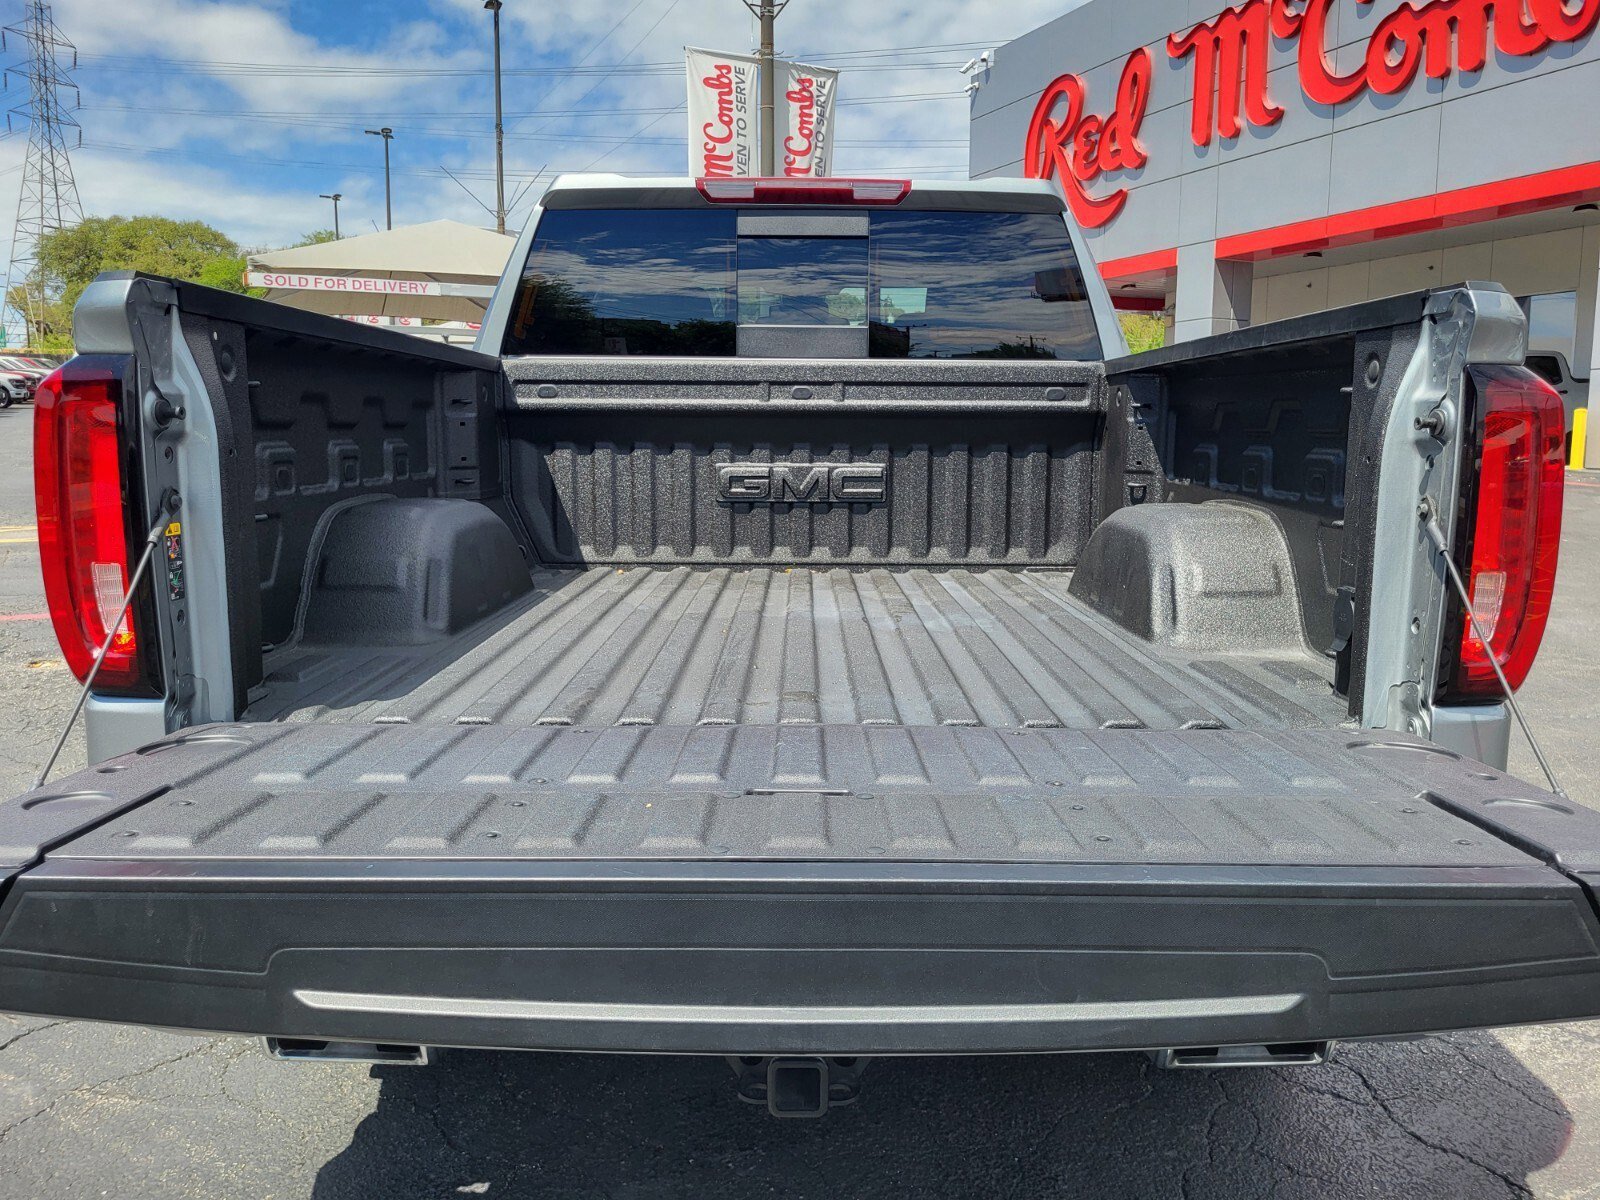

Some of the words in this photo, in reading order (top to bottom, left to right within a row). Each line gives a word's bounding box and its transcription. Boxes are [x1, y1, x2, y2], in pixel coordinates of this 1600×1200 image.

[735, 66, 747, 113] SERVE
[815, 79, 826, 126] SERVE
[703, 64, 734, 177] McCombs
[737, 118, 747, 138] TO
[815, 131, 824, 150] TO
[1025, 47, 1151, 228] Red
[263, 274, 309, 288] SOLD
[314, 277, 347, 290] FOR
[352, 279, 429, 294] DELIVERY
[718, 466, 885, 500] GMC
